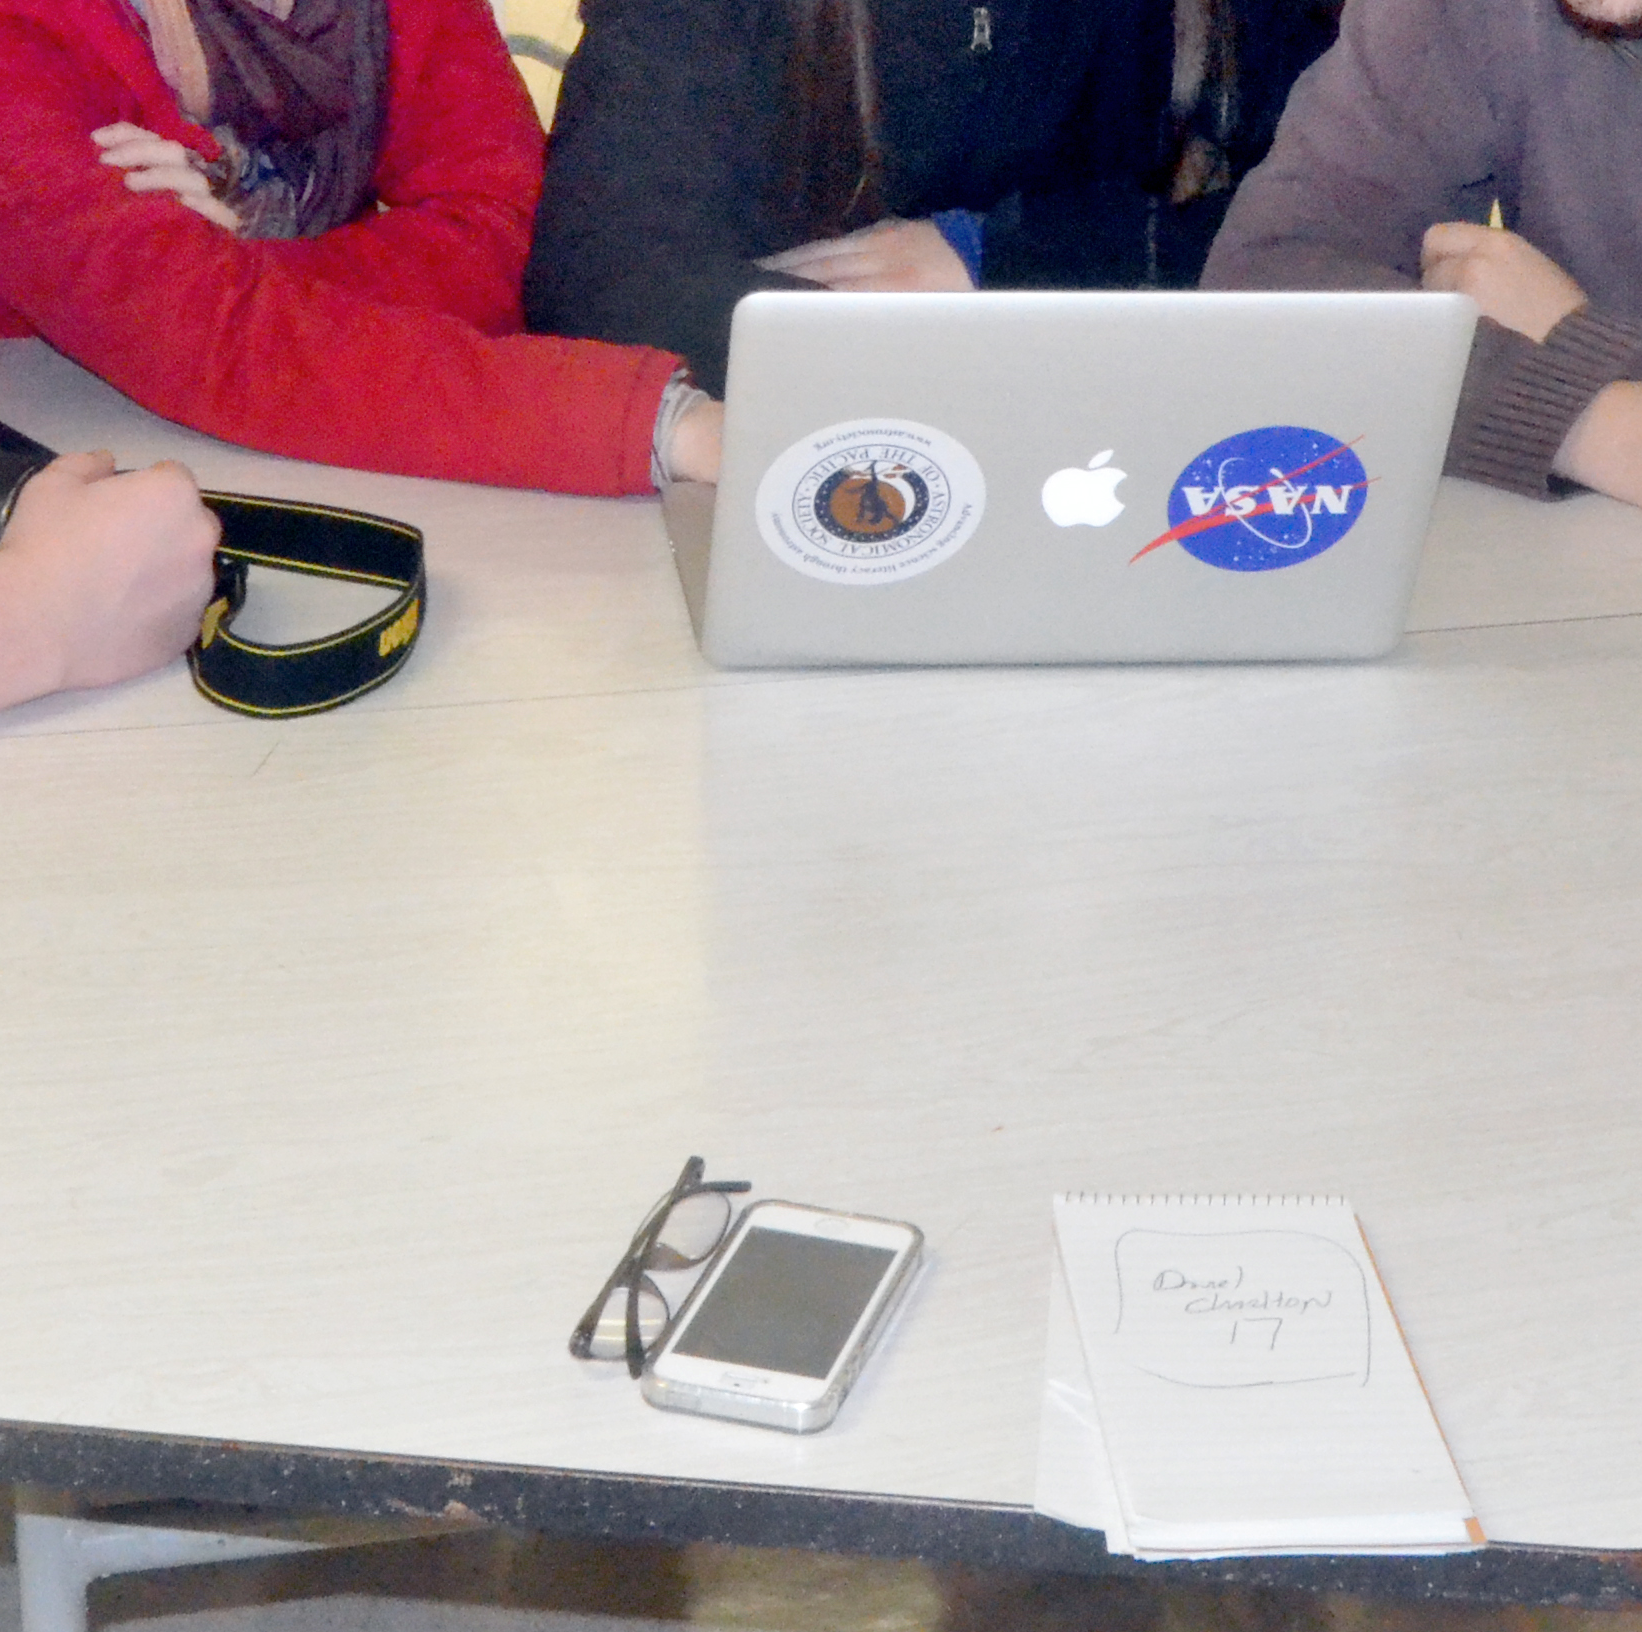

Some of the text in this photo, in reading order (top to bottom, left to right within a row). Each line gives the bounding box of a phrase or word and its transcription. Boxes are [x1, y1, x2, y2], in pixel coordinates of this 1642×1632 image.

[808, 447, 940, 488] OF THE PACIFIC
[1181, 484, 1354, 517] NASA
[796, 491, 946, 556] ASTRONOMICAL SOCIETY
[935, 502, 973, 550] Advancing
[803, 553, 847, 574] through
[851, 563, 896, 576] literacy
[898, 544, 938, 569] science
[1229, 1316, 1283, 1351] 17
